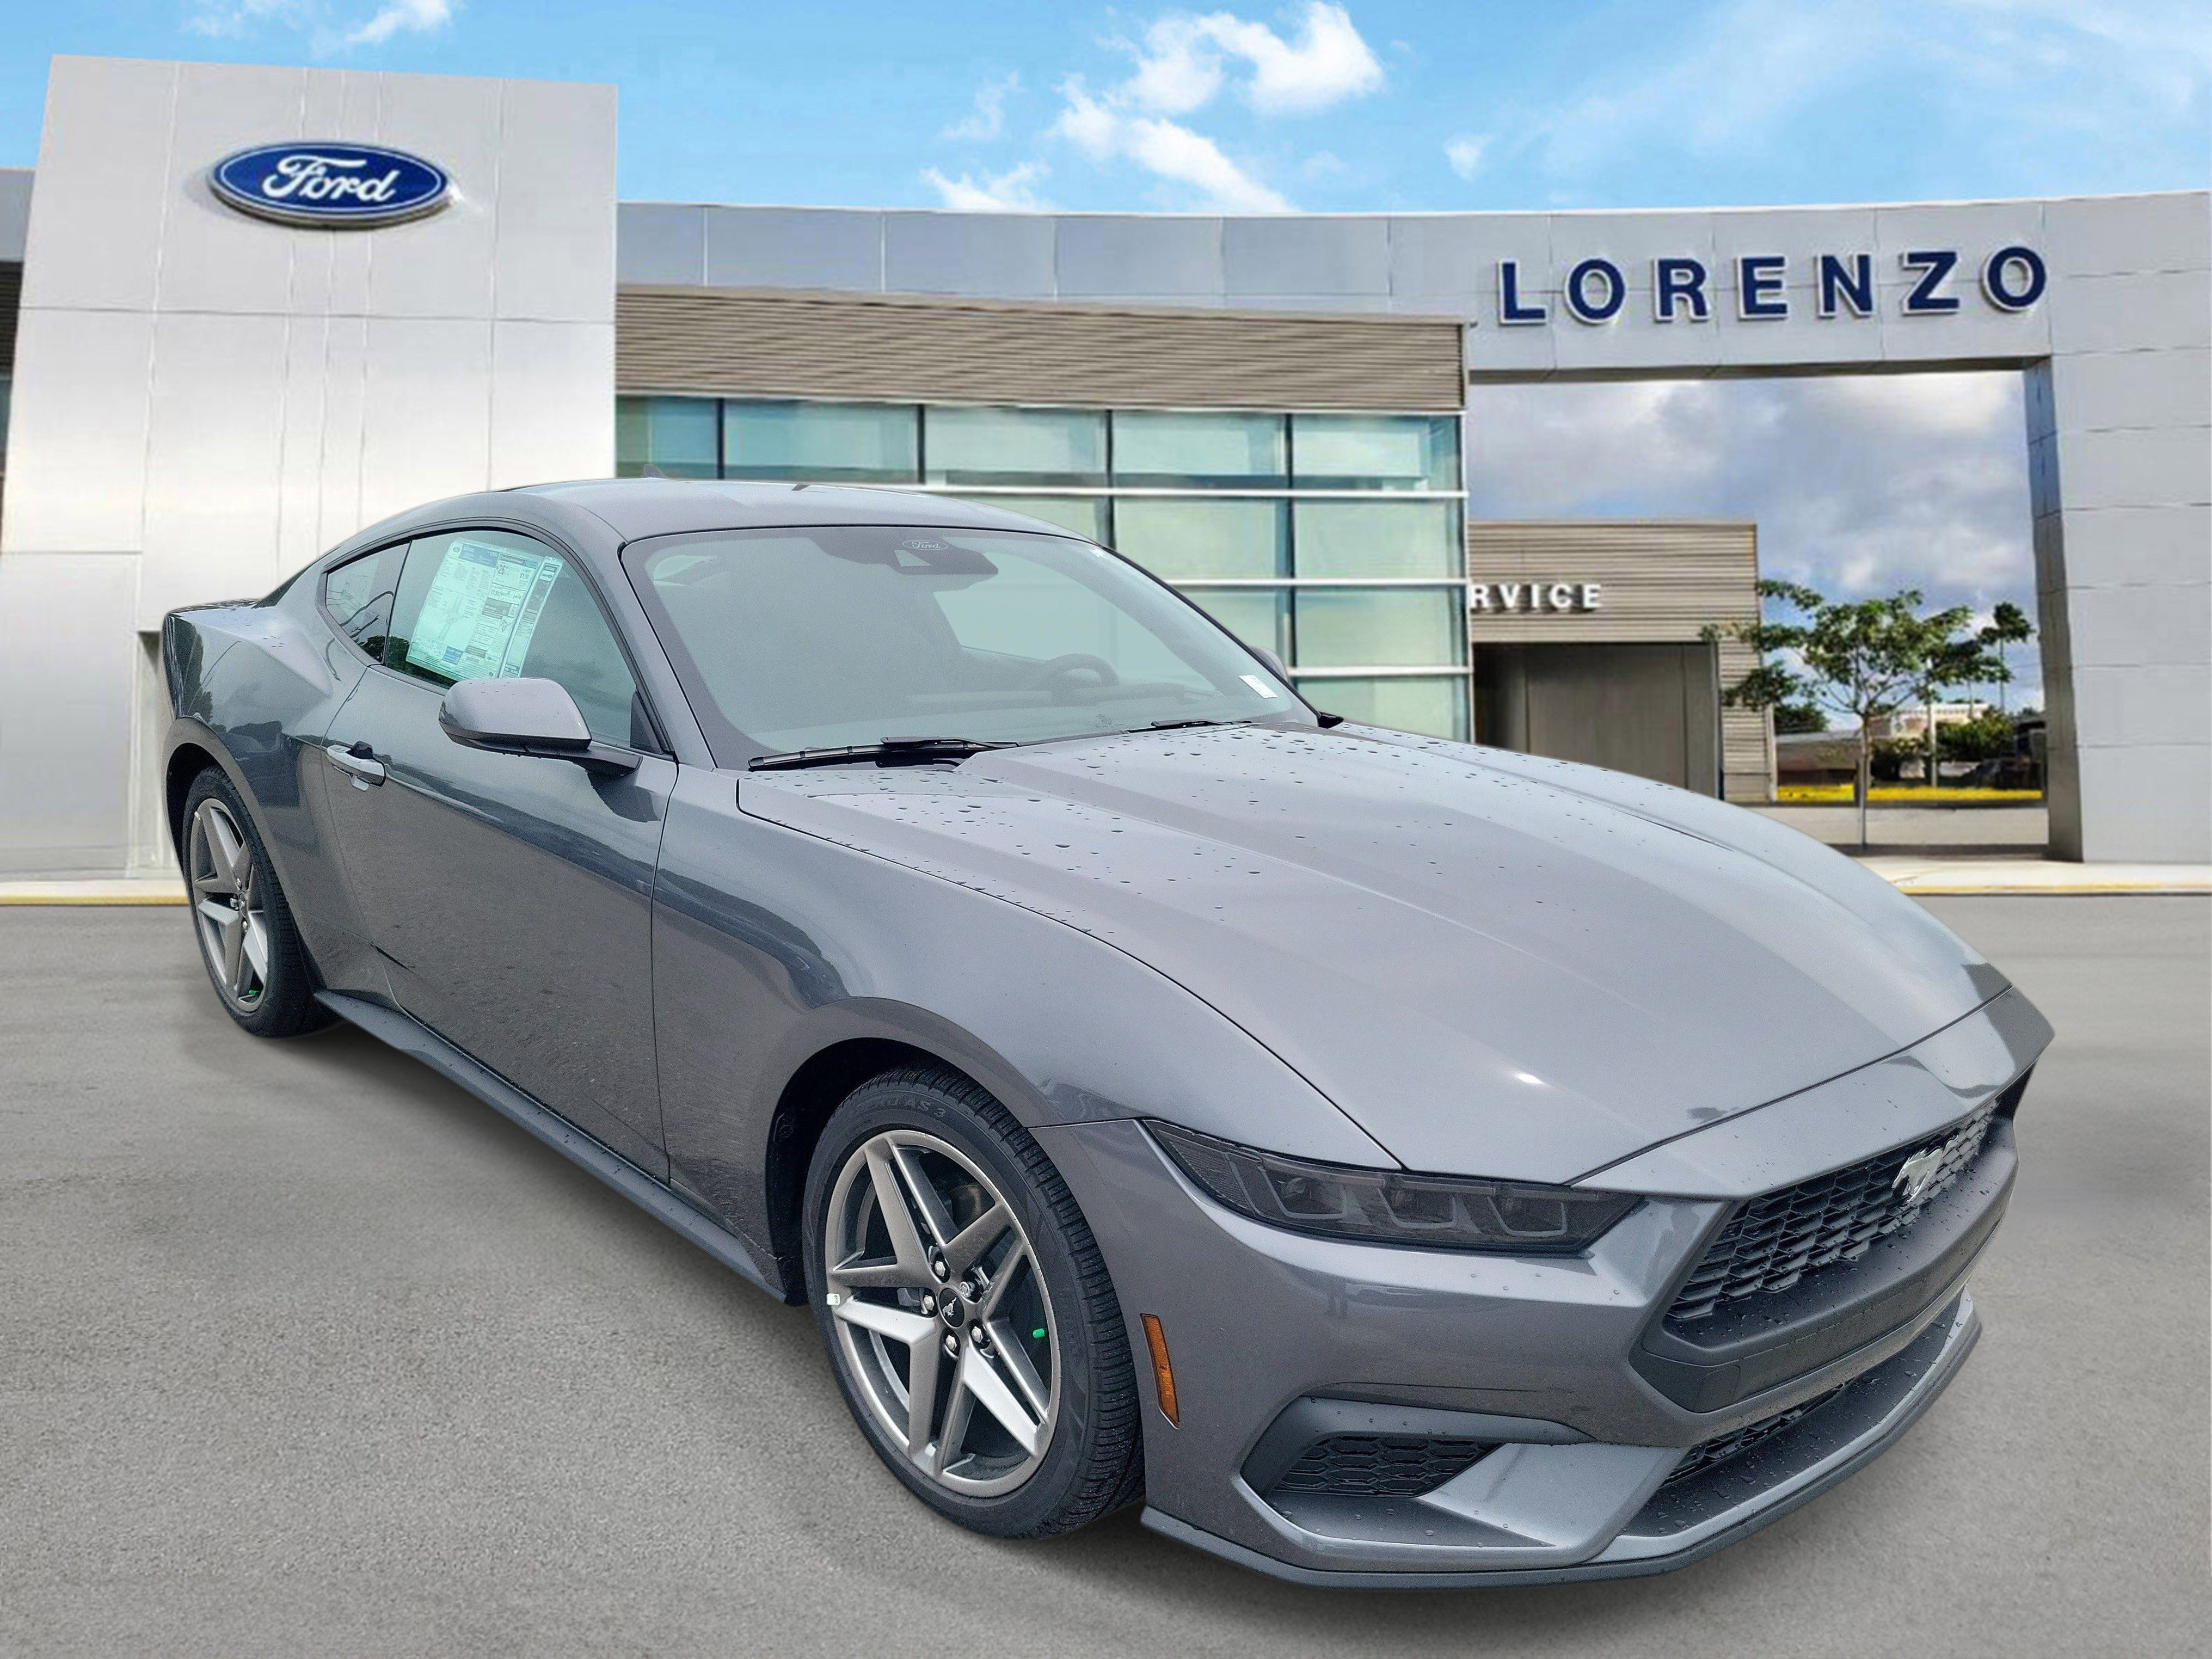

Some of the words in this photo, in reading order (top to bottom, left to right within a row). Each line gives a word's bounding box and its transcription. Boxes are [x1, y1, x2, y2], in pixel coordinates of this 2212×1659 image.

[263, 155, 400, 201] Ford
[1498, 246, 2047, 325] LORENZO
[1470, 583, 1602, 609] RVICE
[904, 1097, 932, 1112] AS
[933, 1108, 947, 1119] 3
